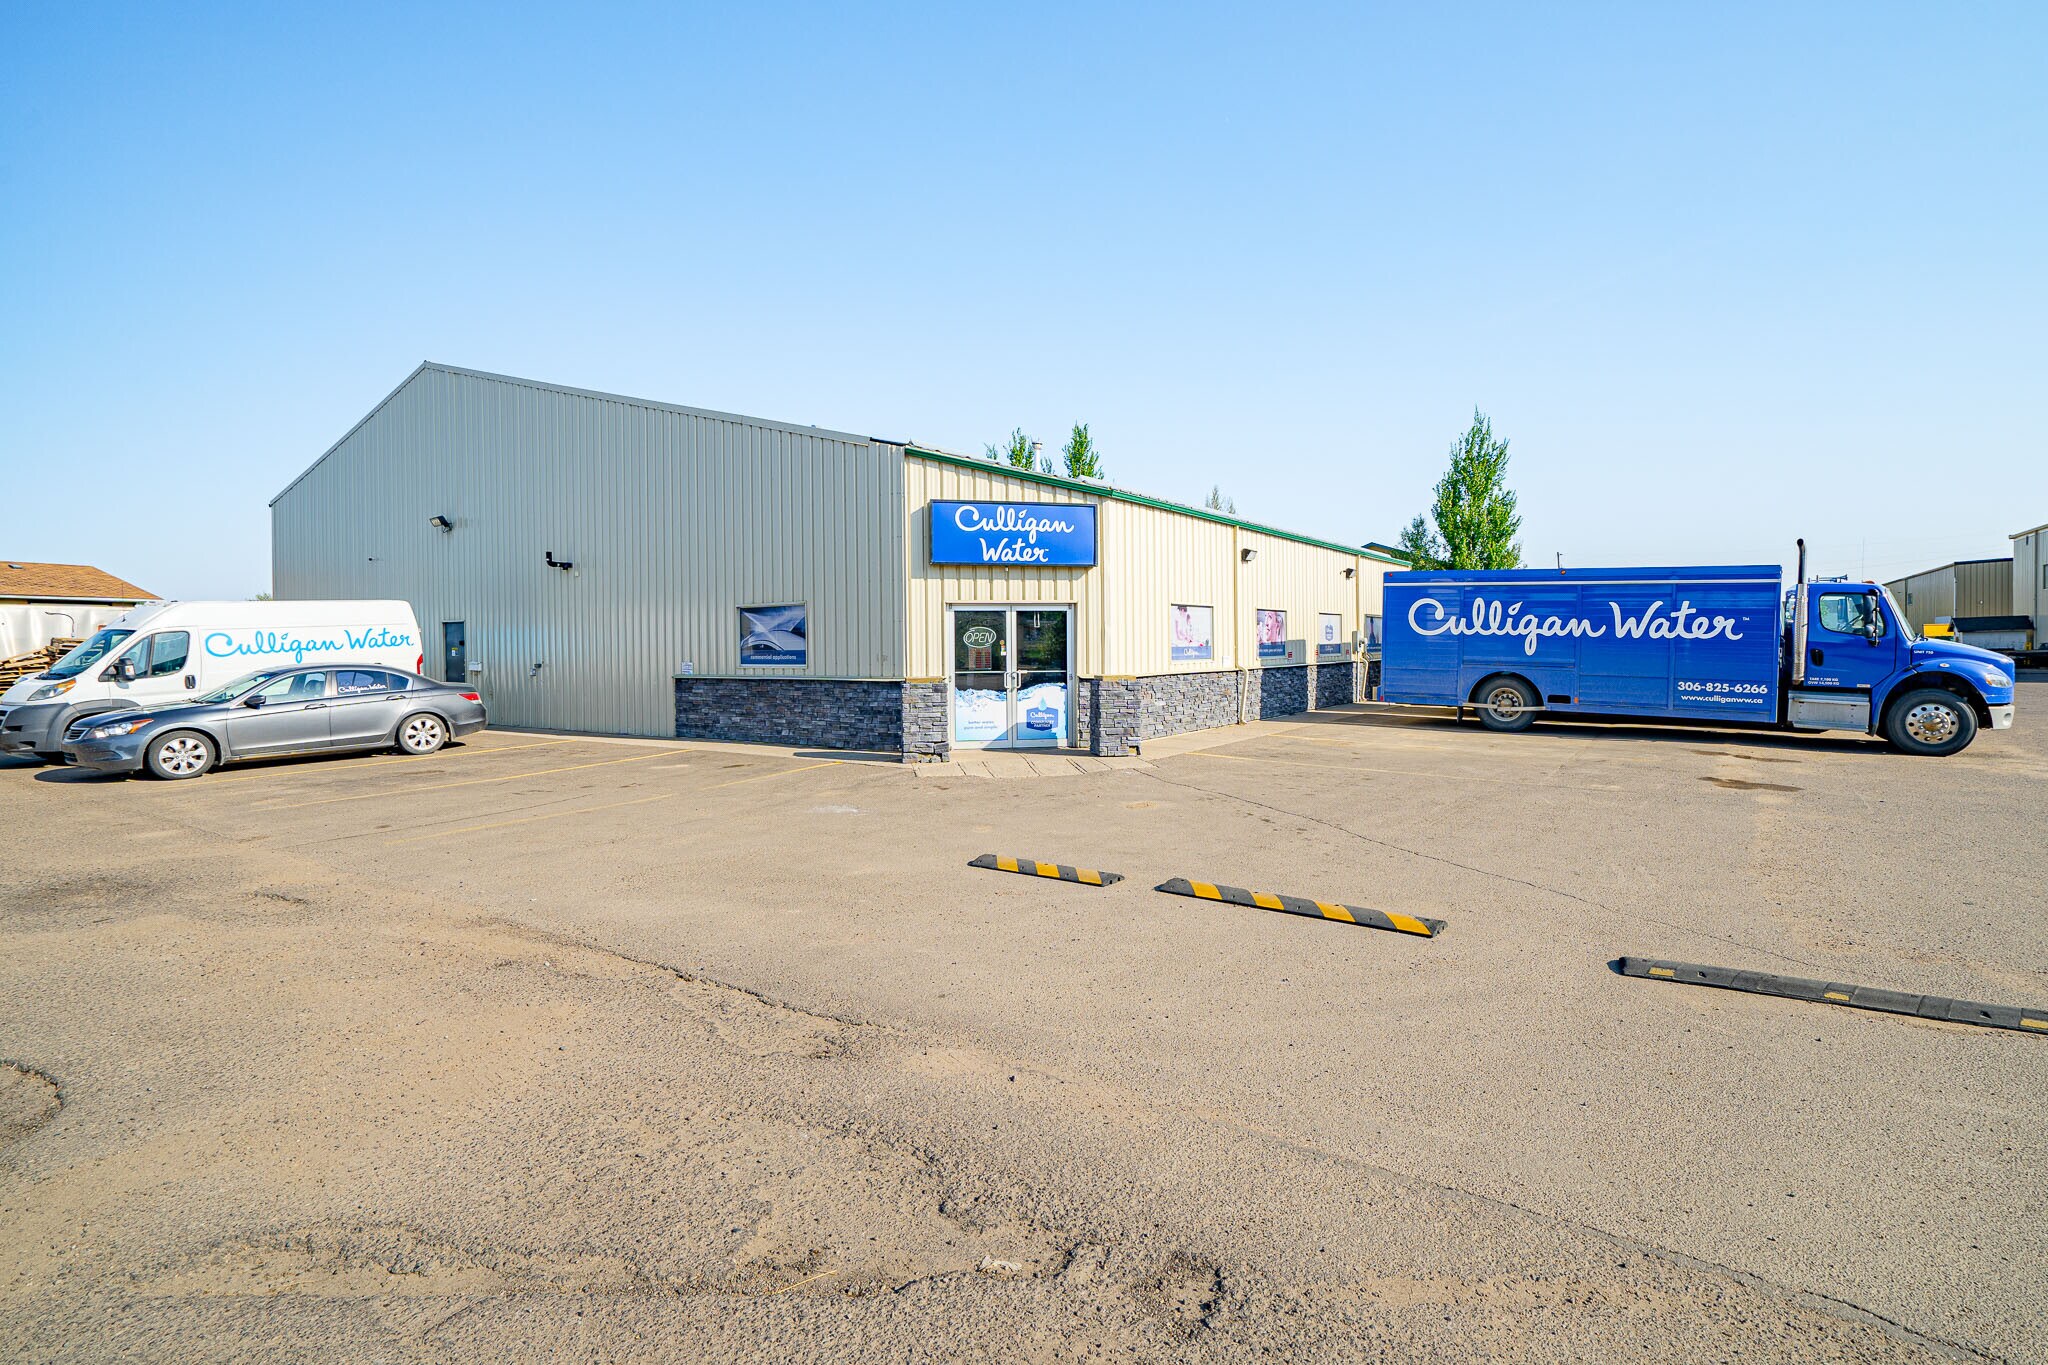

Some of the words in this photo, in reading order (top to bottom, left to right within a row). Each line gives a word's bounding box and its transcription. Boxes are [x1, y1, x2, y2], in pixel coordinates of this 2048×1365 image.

[954, 505, 1075, 544] Culligan
[979, 537, 1048, 562] Water
[965, 632, 994, 643] OPEN
[1408, 597, 1606, 656] Culligan
[1608, 600, 1743, 640] Water
[205, 631, 344, 664] Culligan
[344, 627, 414, 650] Water
[1677, 681, 1768, 694] 306-825-6266
[1681, 695, 1763, 704] www.culliganww.ca
